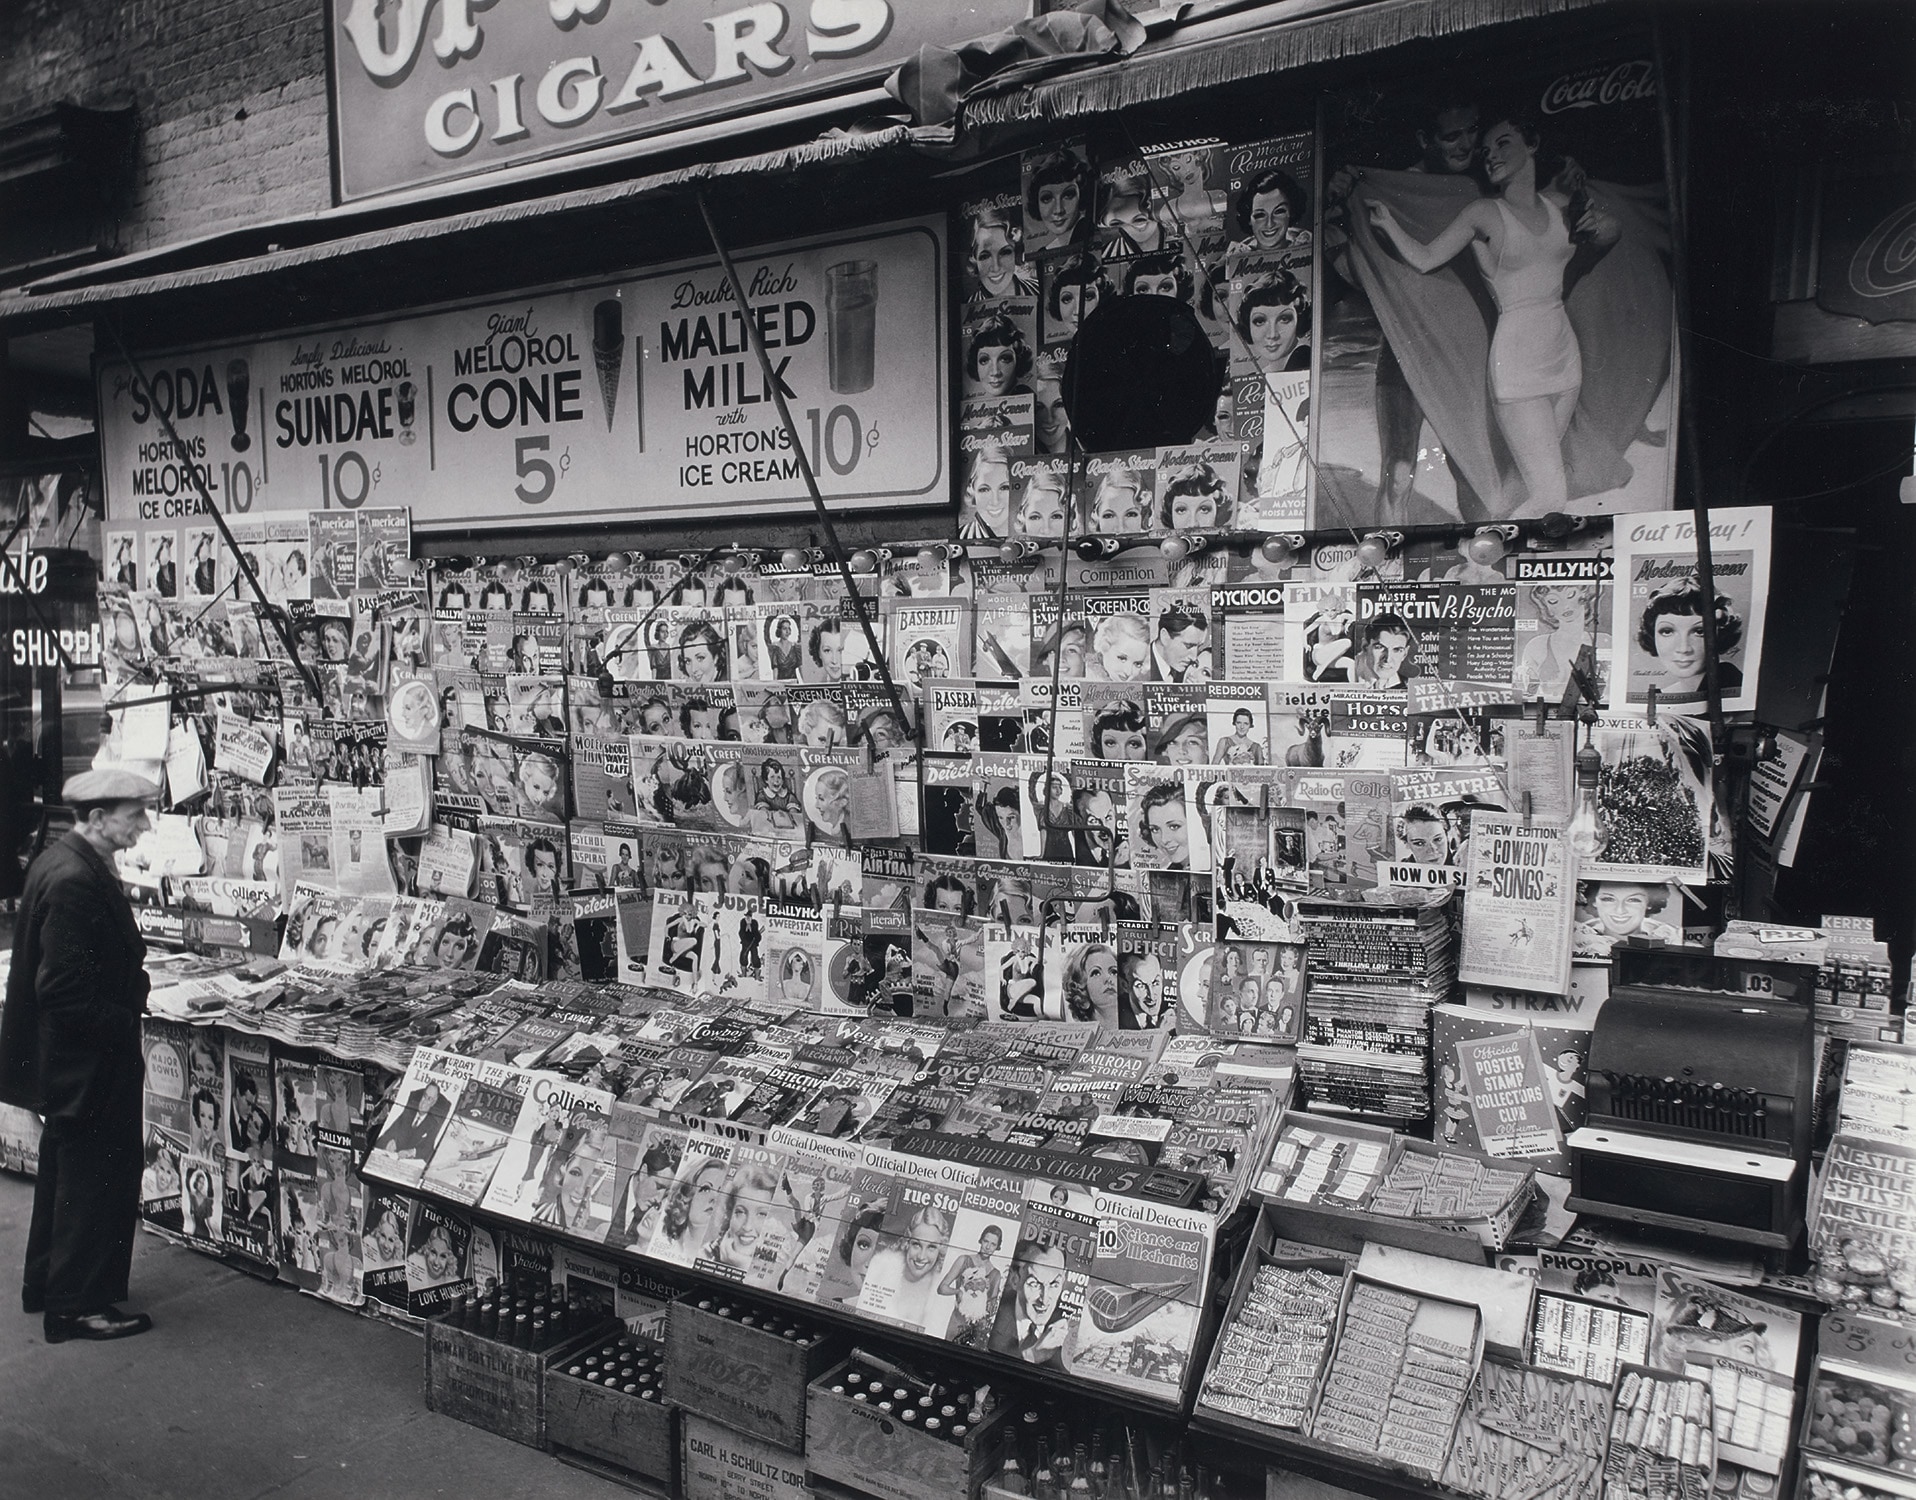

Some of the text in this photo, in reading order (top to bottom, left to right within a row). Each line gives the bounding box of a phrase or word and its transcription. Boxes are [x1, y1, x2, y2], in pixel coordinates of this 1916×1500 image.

[423, 0, 894, 156] CIGARS
[1139, 137, 1220, 155] BALLYHOO
[1257, 140, 1304, 157] Modern
[1230, 151, 1311, 174] Romances
[1230, 181, 1241, 190] 10
[749, 263, 798, 297] Rich
[484, 306, 538, 345] Giant
[661, 300, 817, 363] MALTED
[291, 339, 392, 371] Simply Delicious
[454, 334, 579, 377] MELOROL
[280, 358, 411, 393] HORTON'S MELOROL
[684, 356, 798, 410] MILK
[132, 364, 223, 424] SODA
[447, 370, 584, 432] CONE
[276, 388, 393, 449] SUNDAE
[715, 407, 747, 426] with
[139, 435, 206, 462] HORTON'S
[685, 425, 792, 458] HORTON'S
[961, 432, 1030, 451] Radio Stars
[1011, 459, 1048, 477] Radio
[1157, 449, 1238, 471] Modern Screen
[133, 463, 218, 497] MELOROL
[679, 458, 800, 488] ICE CREAM
[139, 502, 159, 520] ICE
[313, 515, 355, 534] American
[1631, 521, 1736, 544] Out Toay
[1079, 566, 1155, 587] Companion
[1378, 593, 1416, 602] MASTER
[1480, 588, 1497, 596] THE
[1085, 598, 1128, 616] SCREEN
[899, 608, 957, 631] BASEBALL
[515, 625, 561, 636] DETECTIVE
[1208, 685, 1262, 696] REDBOOK
[1414, 681, 1454, 695] NEW
[1420, 690, 1513, 711] THEATRE
[604, 744, 627, 755] SHORT
[605, 755, 629, 764] WAVE
[605, 764, 629, 774] CRAFT
[1396, 771, 1436, 788] NEW
[1400, 776, 1498, 801] THEATRE
[1485, 824, 1558, 839] NEW EDITION
[1493, 840, 1549, 867] COWBOY
[1389, 867, 1448, 885] NOW ON
[1493, 868, 1544, 900] SONGS
[1822, 916, 1873, 930] KERR'S
[1747, 975, 1772, 992] .03
[1492, 992, 1585, 1014] STRAW
[560, 1012, 595, 1025] SAVAGE
[521, 1022, 564, 1038] ARGOSY
[694, 1023, 745, 1040] Cowboy
[151, 1052, 179, 1066] MAJOR
[416, 1050, 432, 1061] THE
[802, 1050, 851, 1065] MECHANIX
[1472, 1043, 1519, 1059] Official
[152, 1065, 179, 1078] BOWES
[922, 1057, 980, 1082] Love
[1079, 1052, 1143, 1071] RAILROAD
[1475, 1056, 1524, 1079] POSTER
[413, 1072, 453, 1092] Liberty
[450, 1069, 474, 1081] POST
[770, 1069, 826, 1089] DETECTIVE
[983, 1065, 1035, 1084] OPERATOR
[1090, 1065, 1138, 1079] STORIES
[1483, 1072, 1524, 1091] STAMP
[532, 1077, 603, 1114] Collier's
[1051, 1080, 1123, 1093] NORTHWEST
[894, 1090, 950, 1110] WESTERN
[1476, 1086, 1543, 1109] COLLECTORS
[482, 1110, 517, 1128] ACES
[1190, 1099, 1257, 1124] SPIDER
[1499, 1108, 1526, 1126] CLUB
[1017, 1112, 1088, 1135] HORROR
[688, 1139, 731, 1159] PICTURE
[772, 1130, 856, 1159] Official Detective
[1171, 1126, 1243, 1153] SPIDER
[904, 1136, 964, 1158] BAYUK
[1047, 1158, 1103, 1182] CIGAR
[963, 1190, 1022, 1217] REDBOOK
[1030, 1213, 1060, 1228] TRUE
[1094, 1197, 1208, 1233] Official Detective
[1099, 1231, 1117, 1247] 10
[1116, 1222, 1199, 1255] Science and
[511, 1253, 548, 1273] Shadow
[1126, 1244, 1199, 1271] Mechanics
[1541, 1252, 1661, 1279] PHOTOPLAY
[418, 1290, 446, 1307] LOVE
[1662, 1270, 1799, 1321] SCREENLAND
[1828, 1317, 1870, 1336] 5 FOR
[1715, 1358, 1765, 1381] Chiclets
[691, 1439, 716, 1459] CARL
[719, 1449, 729, 1463] H.
[731, 1453, 778, 1480] SCHULTZ
[727, 1470, 773, 1493] BERRY STREET
